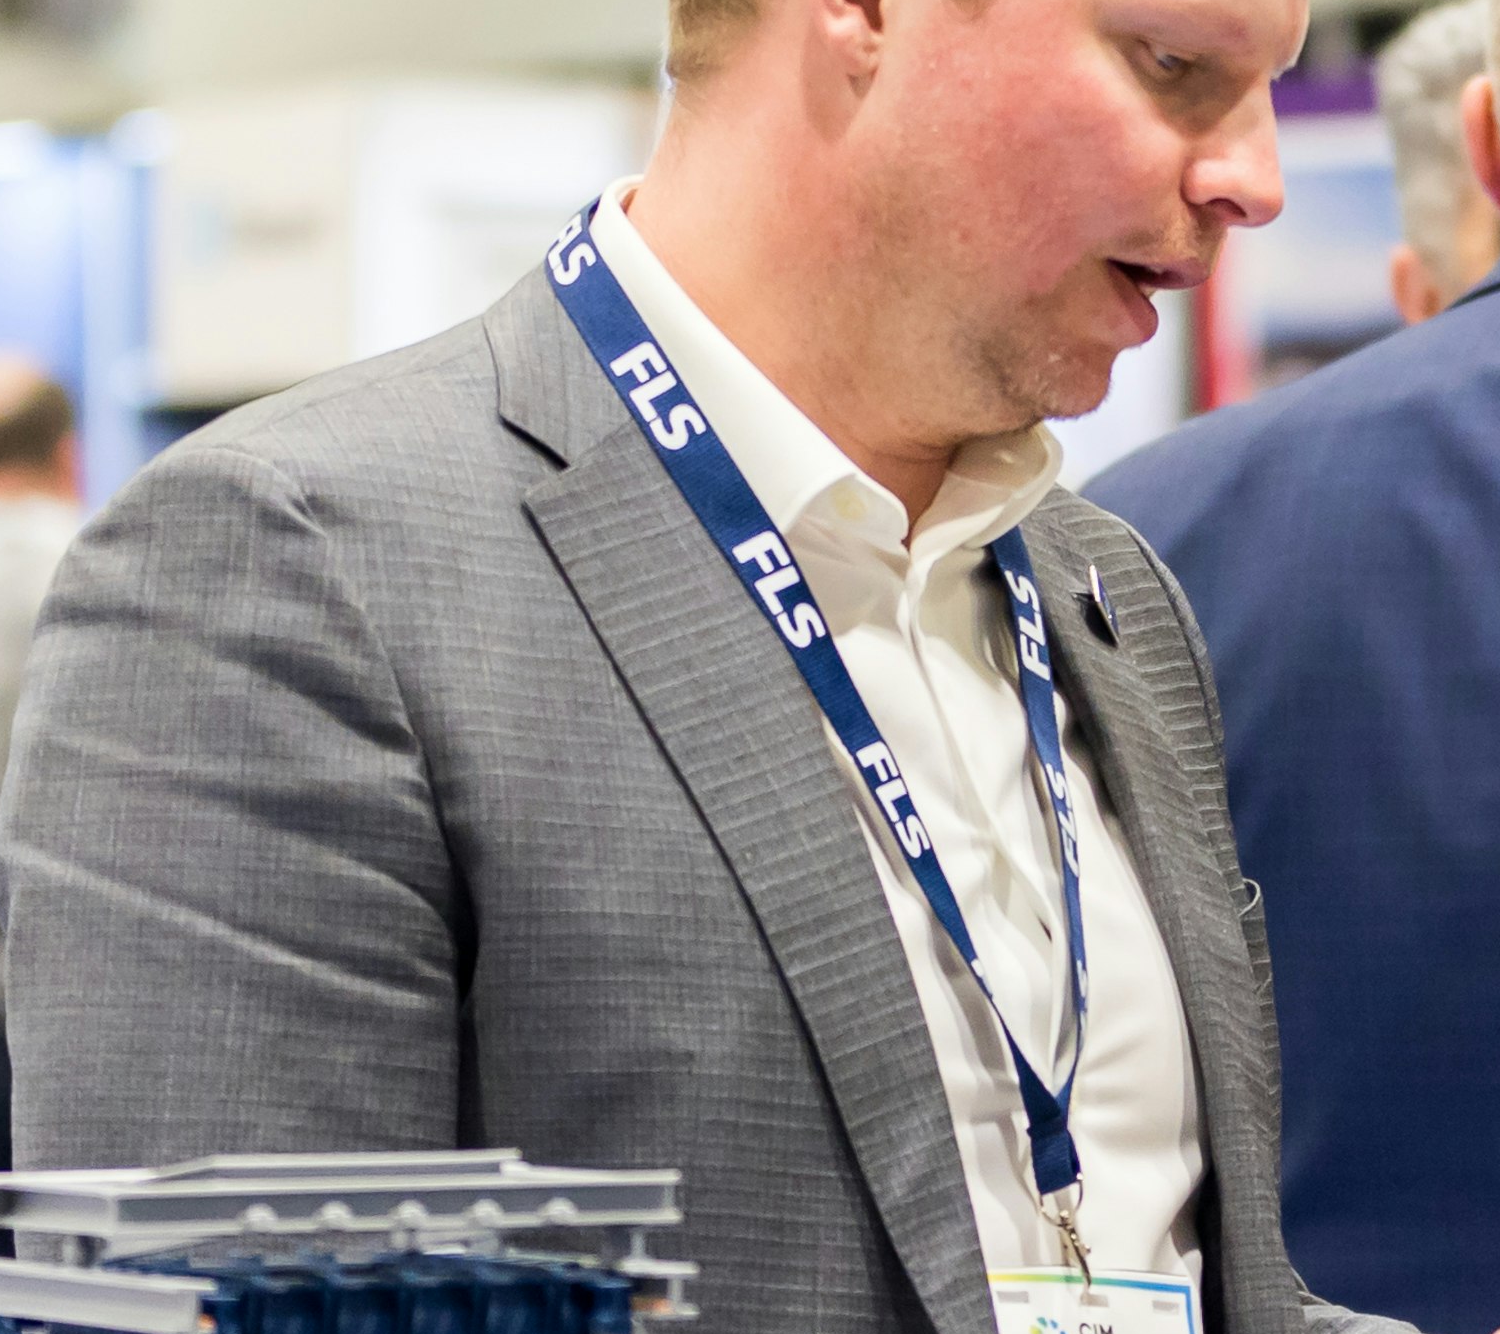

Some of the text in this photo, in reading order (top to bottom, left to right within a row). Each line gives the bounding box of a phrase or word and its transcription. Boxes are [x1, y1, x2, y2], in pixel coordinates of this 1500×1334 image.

[609, 340, 708, 451] FLS
[731, 529, 827, 649] FLS
[1004, 570, 1051, 682] FLS
[855, 740, 931, 859] FLS
[1046, 763, 1080, 878] FLS
